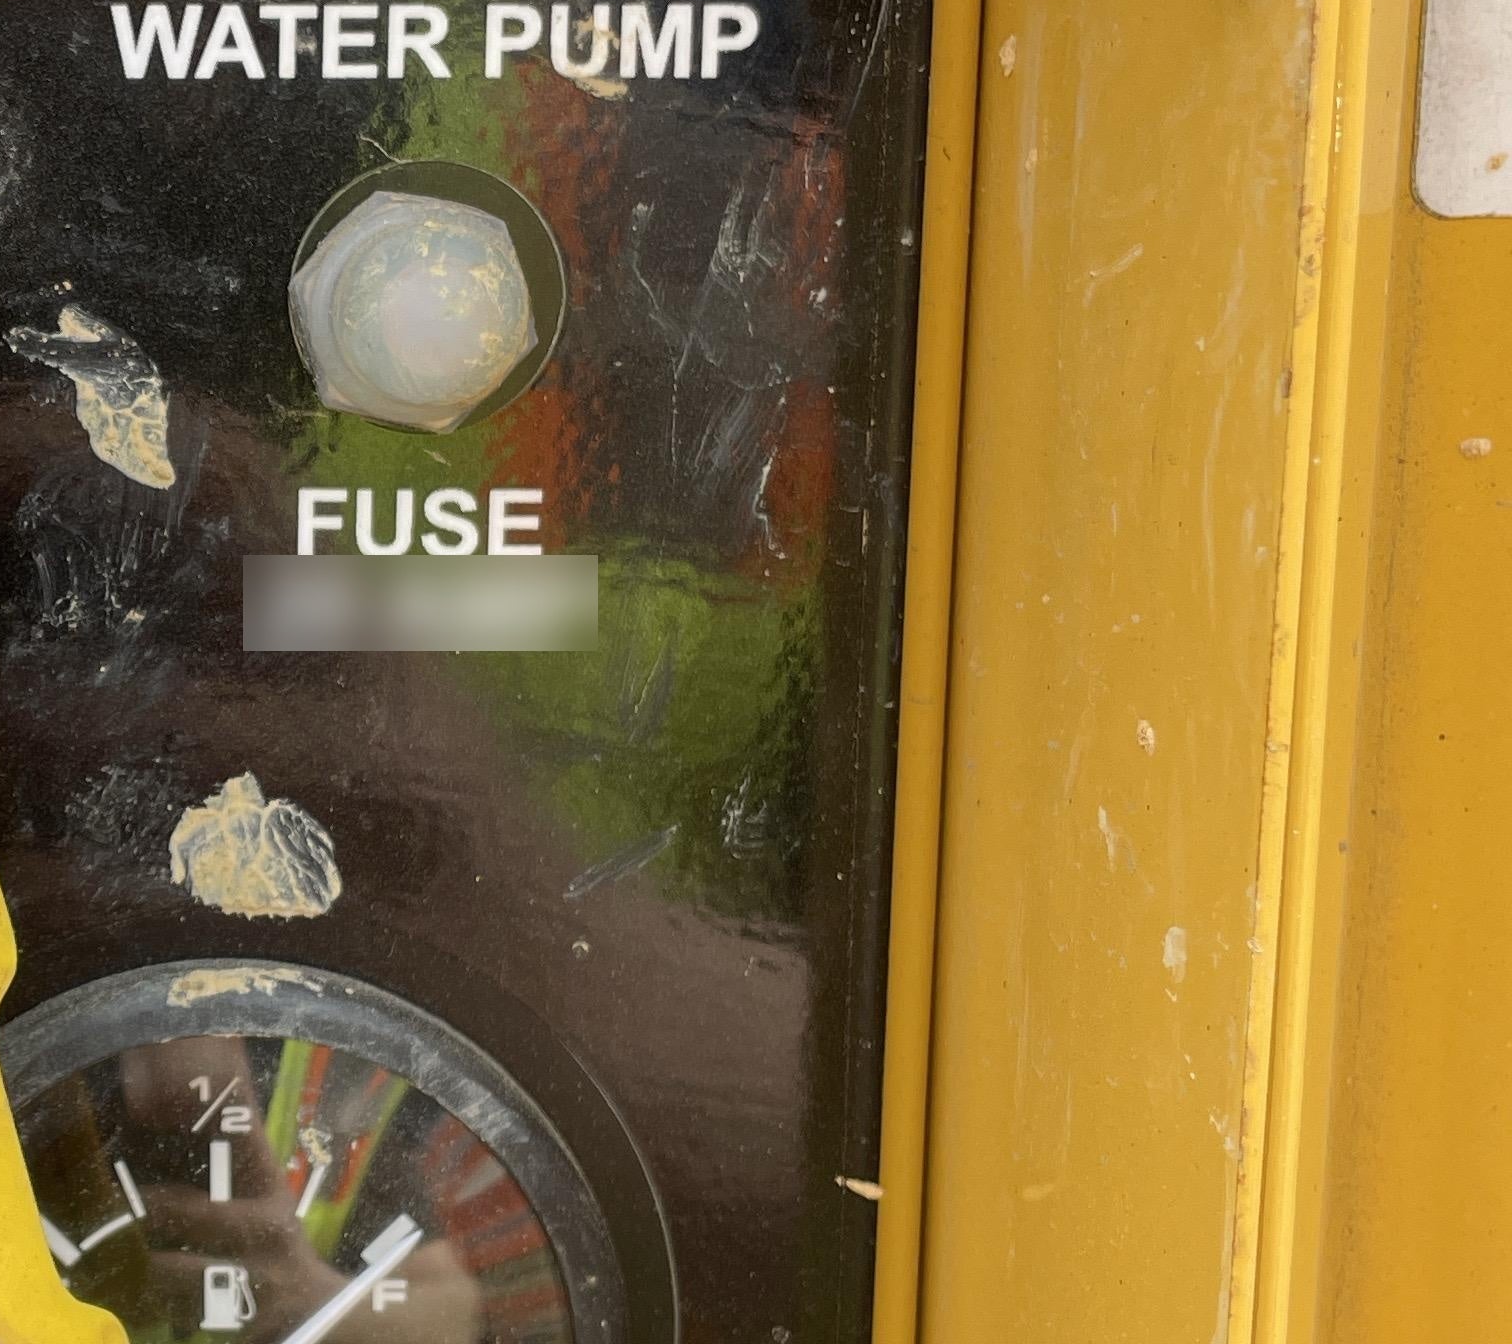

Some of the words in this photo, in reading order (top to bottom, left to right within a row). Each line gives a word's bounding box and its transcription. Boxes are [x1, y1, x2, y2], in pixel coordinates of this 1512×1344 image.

[110, 3, 450, 80] WATER
[485, 2, 760, 80] PUMP
[297, 487, 543, 556] FUSE
[371, 1279, 408, 1312] F
